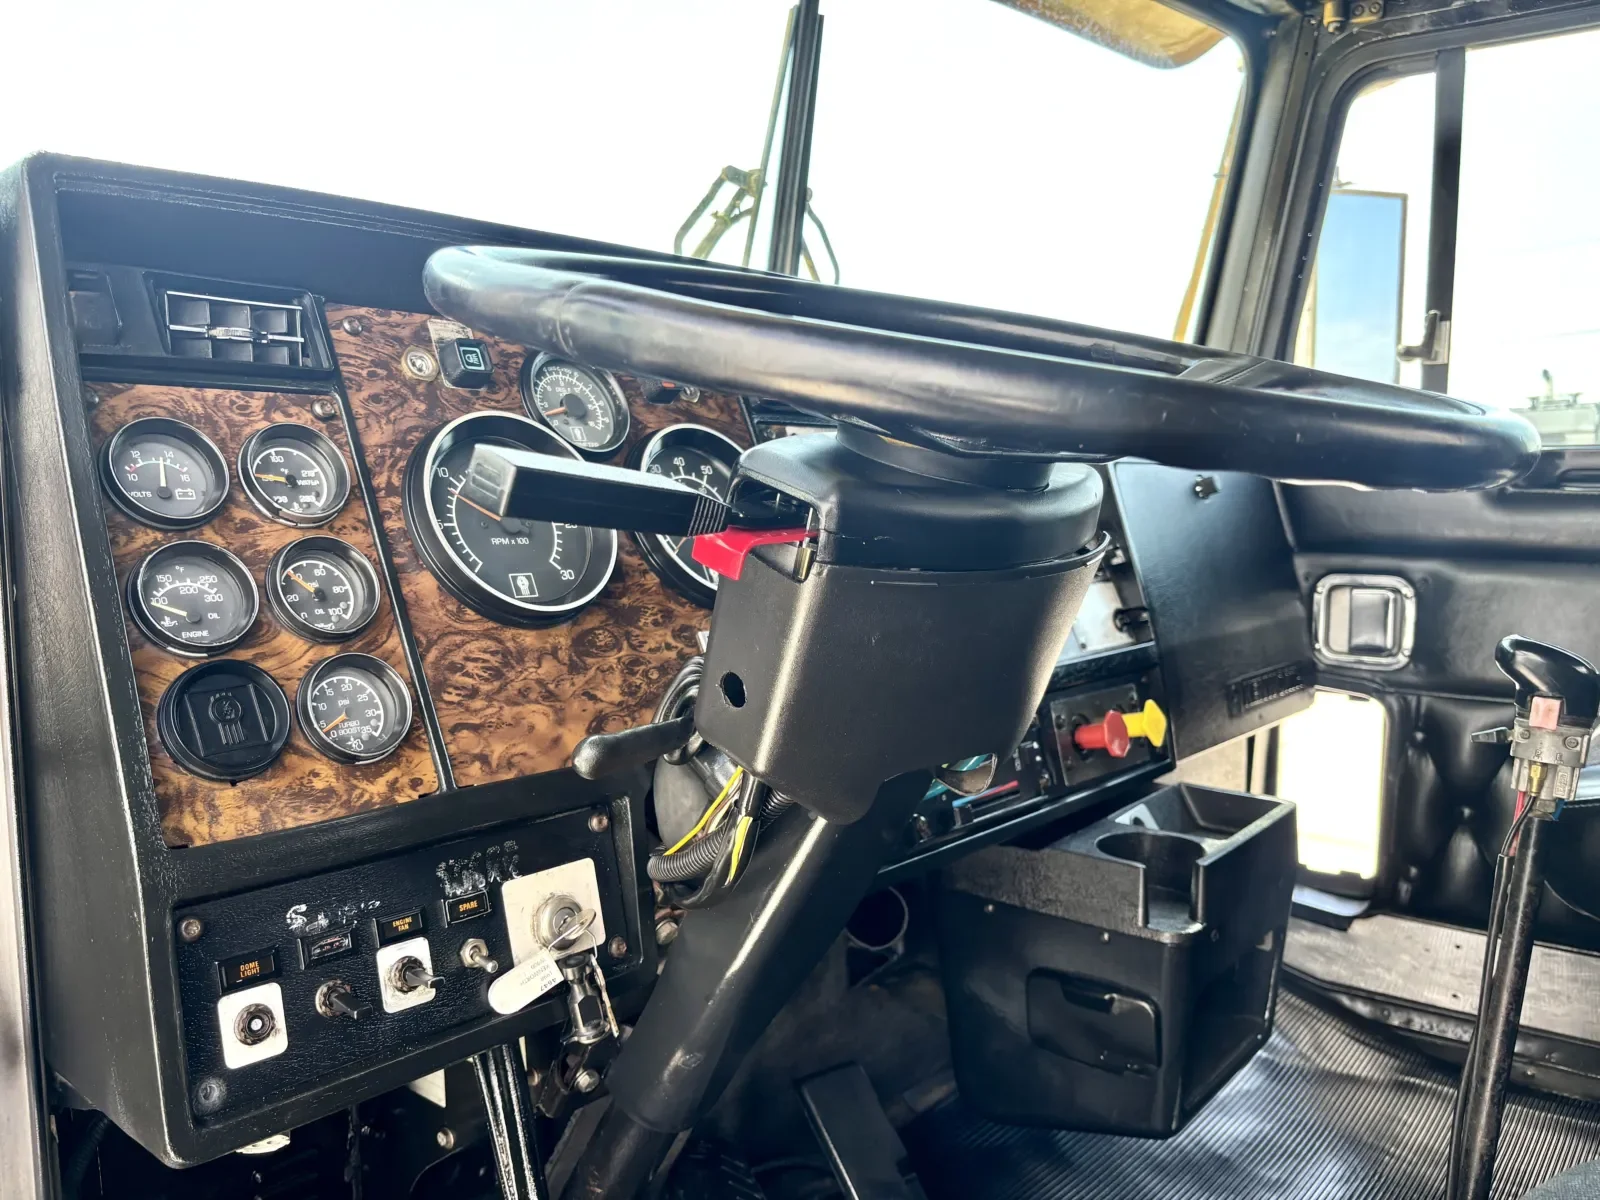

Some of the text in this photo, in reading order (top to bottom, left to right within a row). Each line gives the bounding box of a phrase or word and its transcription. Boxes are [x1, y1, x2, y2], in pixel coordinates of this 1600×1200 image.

[130, 450, 140, 459] 12
[164, 450, 174, 459] 14
[673, 456, 685, 466] 40
[437, 467, 449, 478] 10
[650, 464, 662, 474] 30
[700, 465, 713, 476] 50
[126, 473, 138, 482] 10
[180, 474, 190, 482] 16
[128, 490, 152, 498] VOLTS
[490, 537, 510, 545] RPM
[516, 537, 530, 545] 100
[314, 568, 326, 577] 60
[560, 569, 575, 580] 30
[156, 574, 172, 583] 150
[199, 574, 218, 584] 250
[179, 586, 198, 595] 200
[333, 586, 345, 594] 80
[204, 594, 224, 603] 300
[287, 594, 300, 602] 20
[327, 608, 342, 616] 100
[182, 630, 209, 639] ENGINE
[326, 688, 334, 696] 15
[341, 683, 353, 692] 20
[338, 697, 350, 706] psi
[357, 694, 369, 702] 25
[317, 702, 327, 711] 10
[365, 708, 377, 717] 30
[320, 720, 326, 728] 5
[338, 720, 360, 728] TURBO
[330, 730, 337, 738] 0
[338, 727, 361, 736] BOOST
[361, 726, 373, 734] 35
[459, 900, 478, 912] SPARE
[392, 916, 413, 928] ENGINE
[398, 923, 410, 932] FAN
[240, 960, 259, 972] DOME
[240, 966, 260, 978] LIGHT
